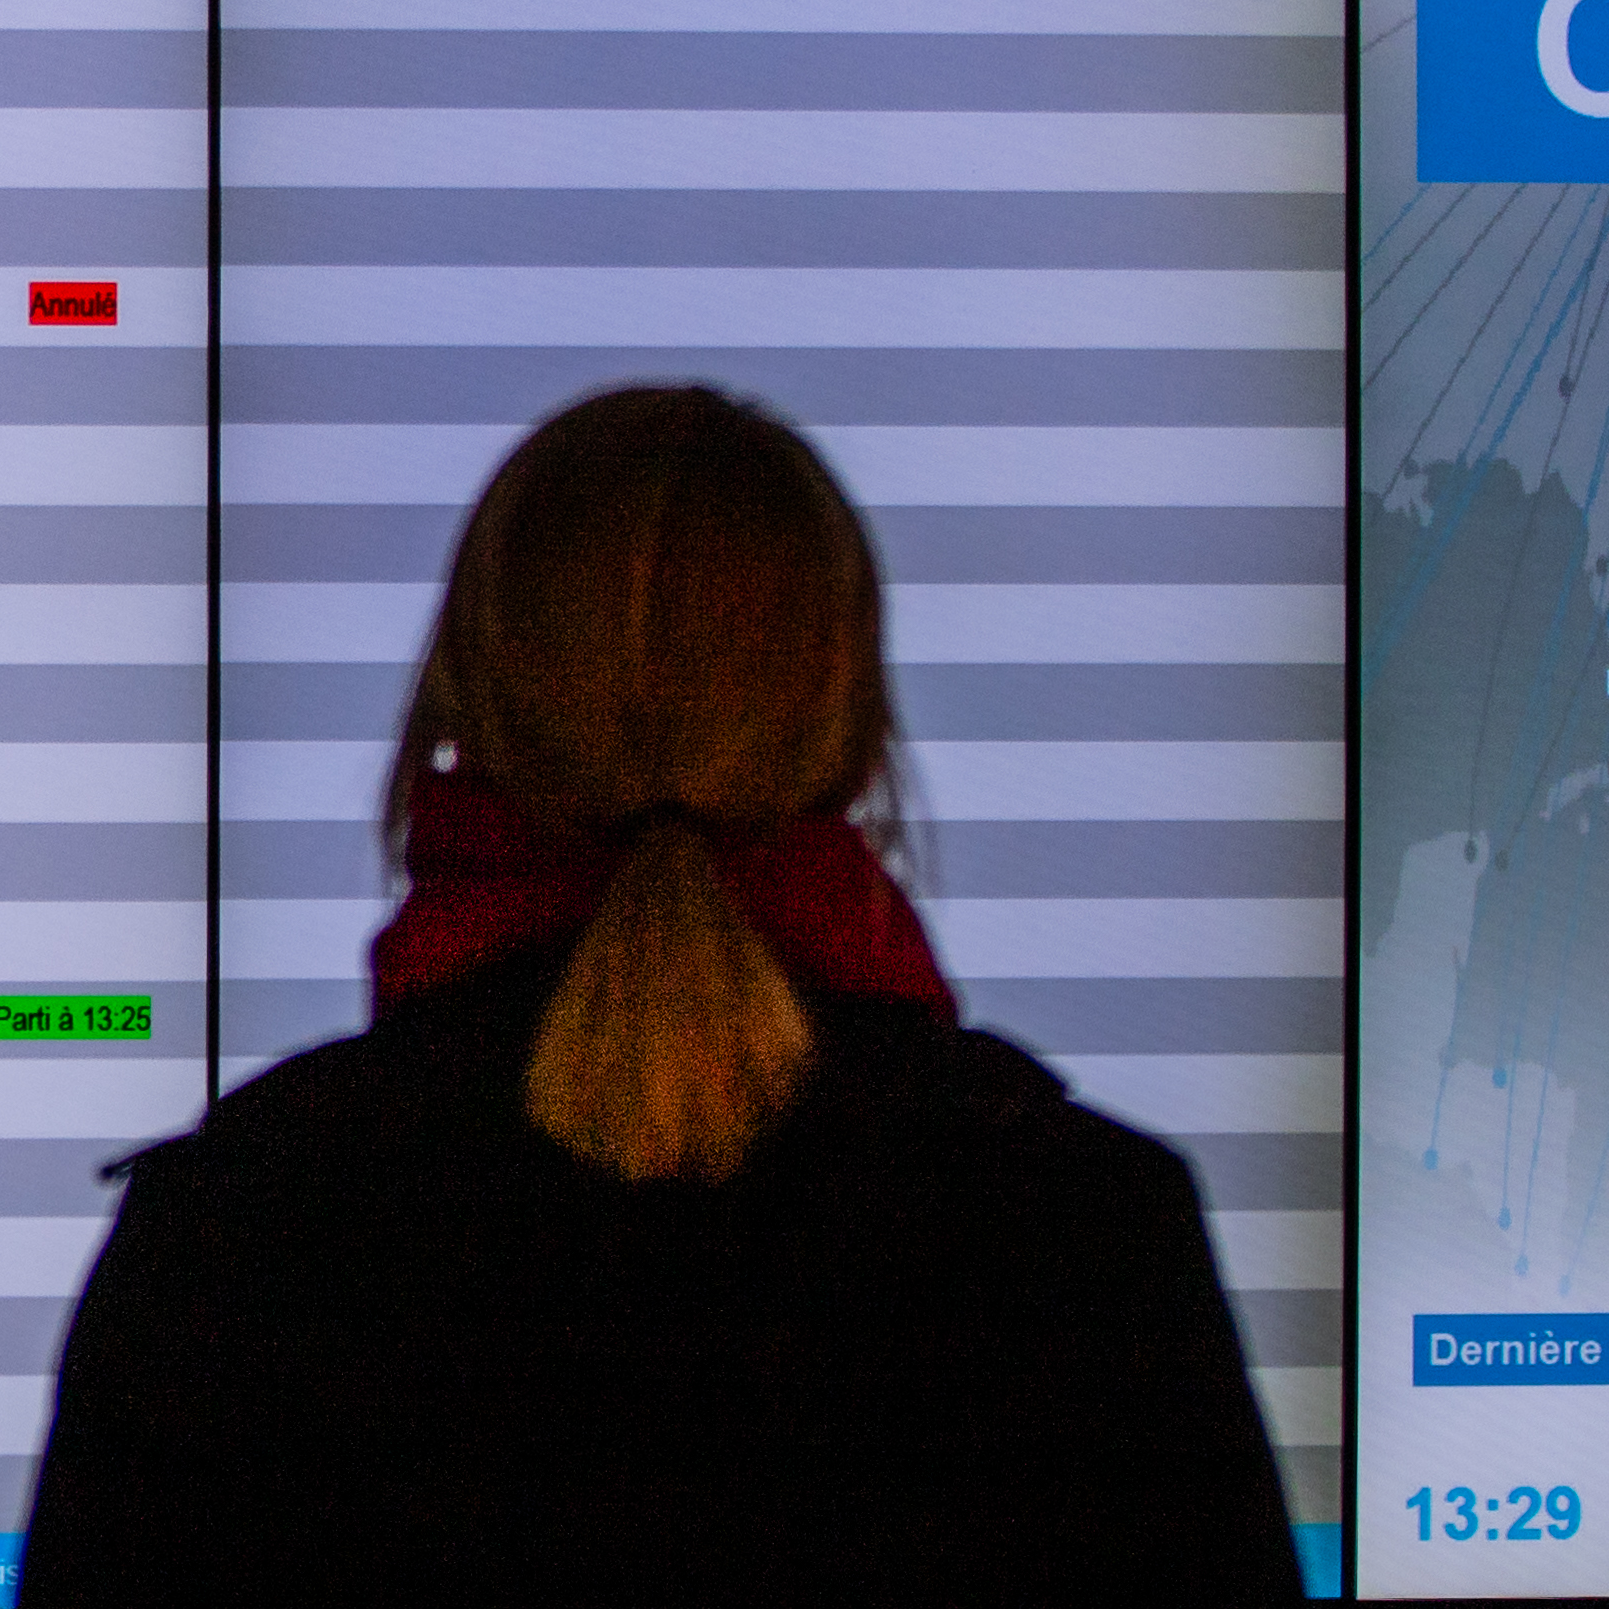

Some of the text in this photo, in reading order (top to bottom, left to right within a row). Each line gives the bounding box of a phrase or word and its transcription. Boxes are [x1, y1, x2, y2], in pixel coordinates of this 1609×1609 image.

[31, 290, 116, 317] Annulé
[1429, 1330, 1600, 1366] Dernière
[1406, 1485, 1581, 1541] 13:29
